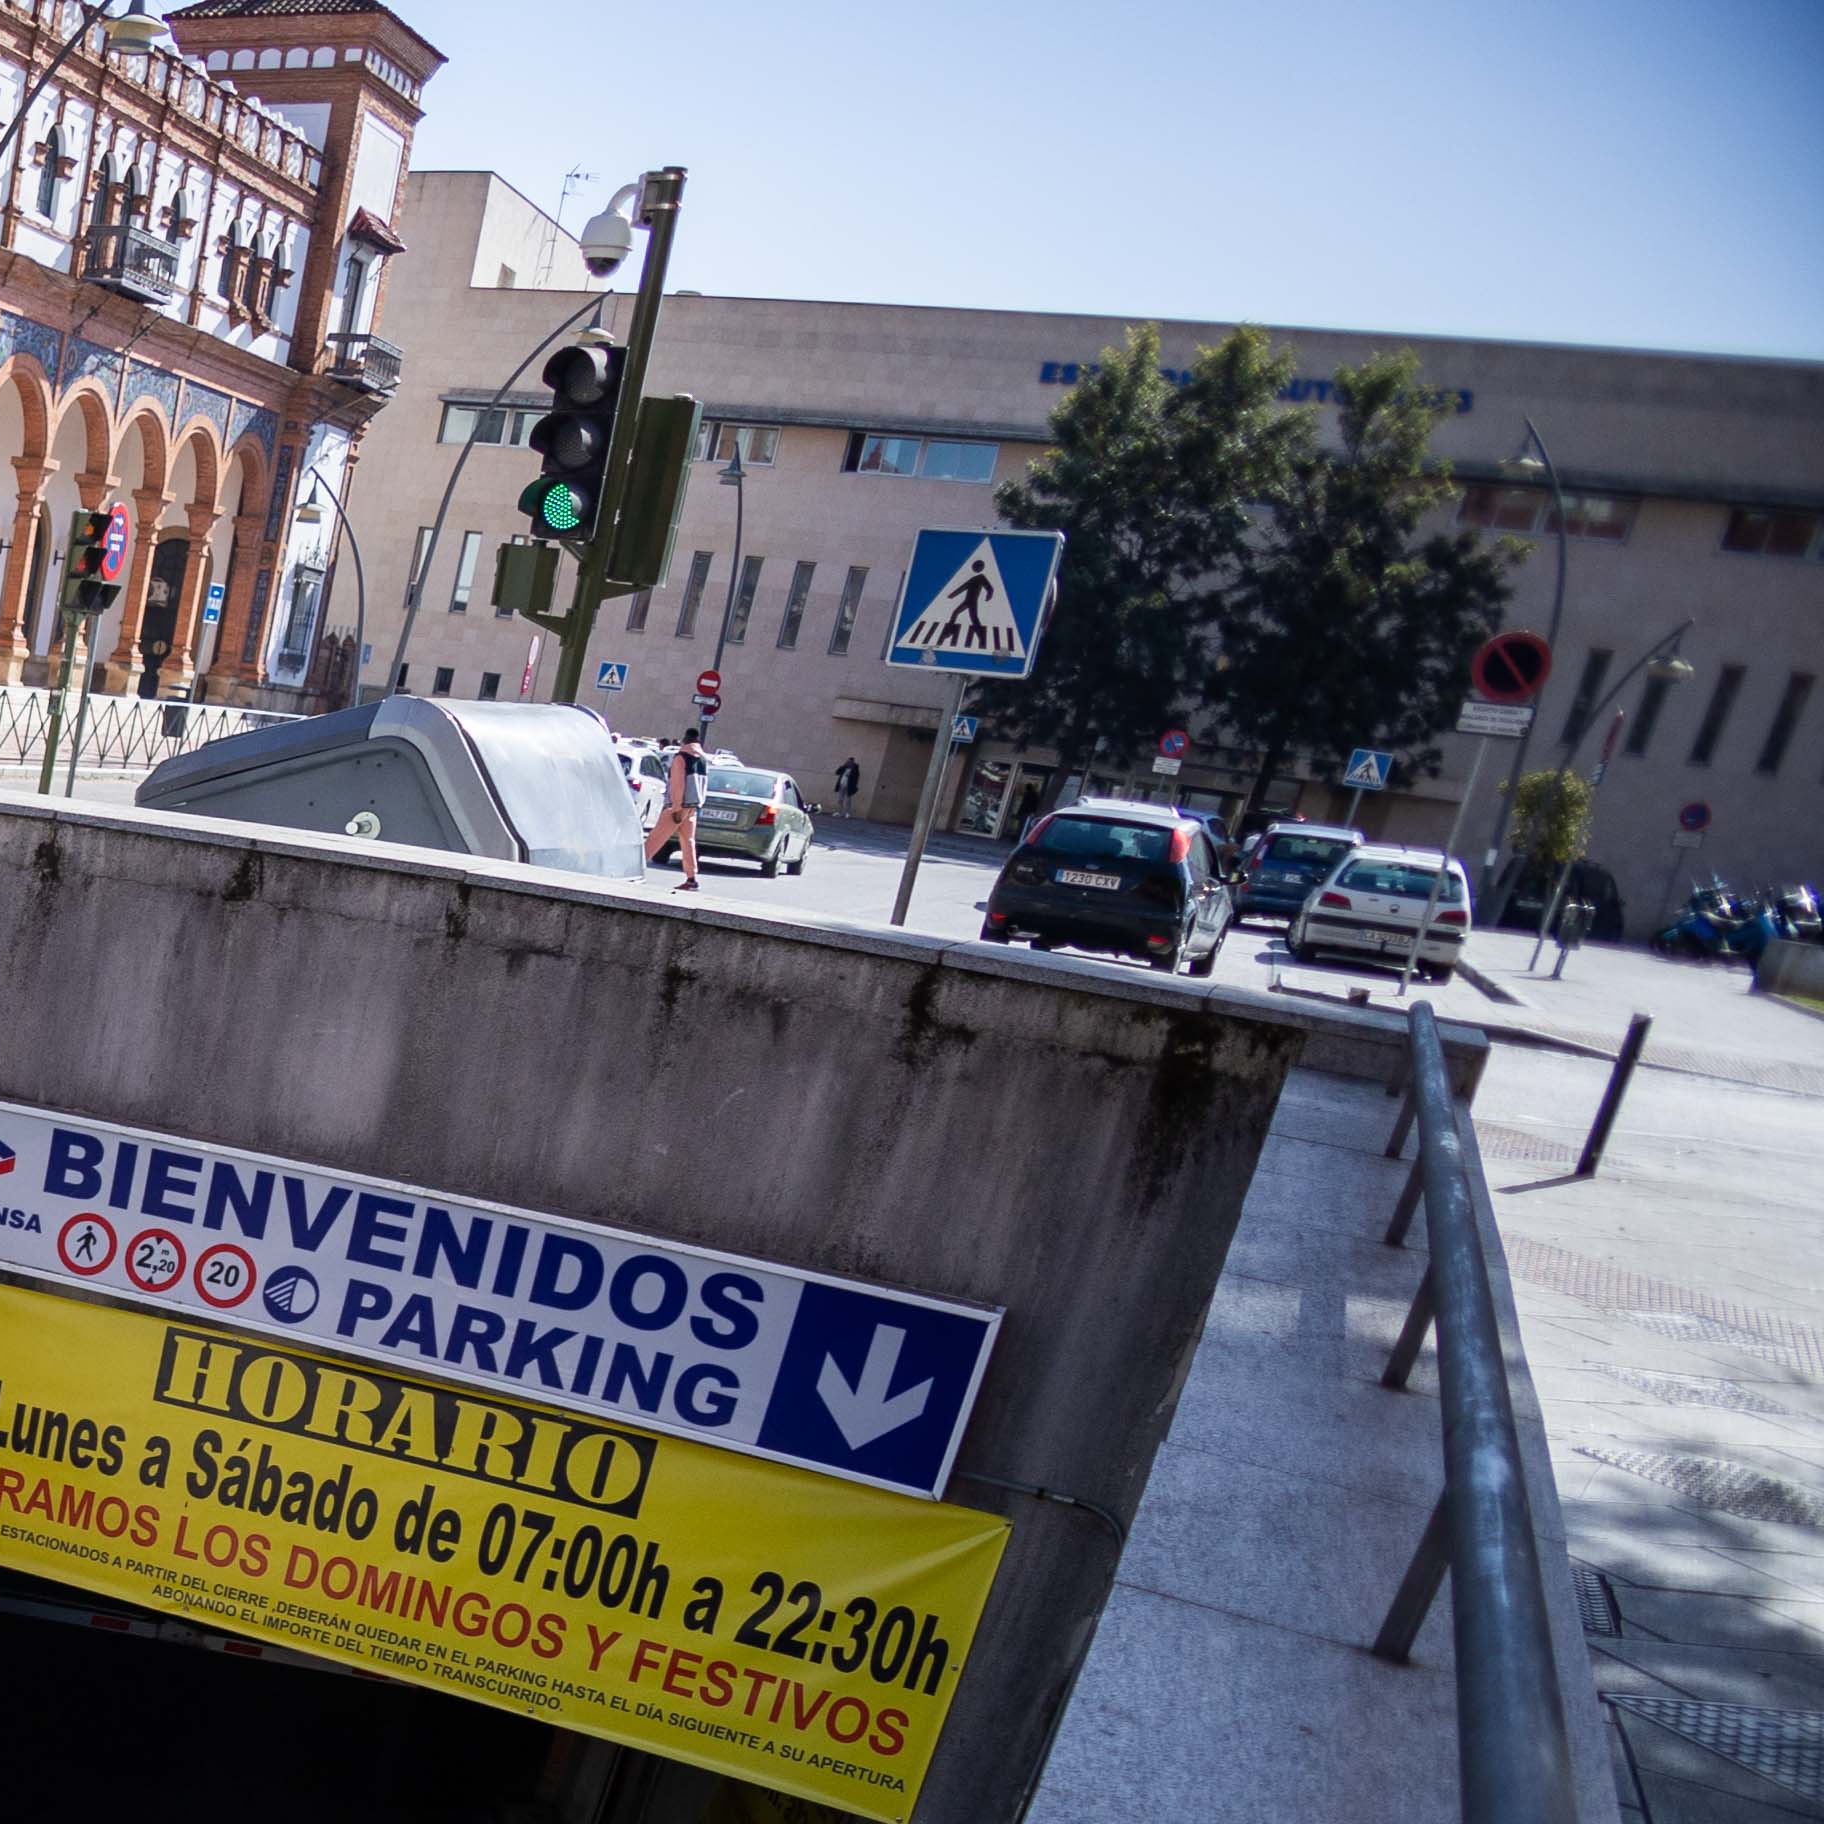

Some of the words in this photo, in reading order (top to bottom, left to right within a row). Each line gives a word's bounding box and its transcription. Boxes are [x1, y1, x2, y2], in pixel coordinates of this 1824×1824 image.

[43, 1127, 765, 1351] BIENVENIDOS
[206, 1260, 240, 1288] 20
[163, 1334, 641, 1508] HORARIO
[336, 1278, 740, 1427] PARKING
[0, 1524, 110, 1564] ESTACIONADOS
[111, 1555, 123, 1570] A
[125, 1558, 177, 1584] PARTIR
[180, 1574, 209, 1593] DEL
[213, 1583, 269, 1609] CIERRE
[354, 1623, 421, 1650] QUEDAR
[425, 1642, 448, 1659] EN
[451, 1650, 471, 1667] EL
[474, 1657, 548, 1688] PARKING
[551, 1678, 606, 1705] HASTA
[609, 1695, 630, 1711] EL
[635, 1703, 663, 1722] DÍA
[668, 1713, 761, 1750] SIGUIENTE
[762, 1741, 775, 1754] A
[779, 1744, 806, 1762] SU
[806, 1753, 906, 1793] APERTURA
[138, 1435, 172, 1489] a
[185, 1429, 379, 1541] Sábado
[393, 1484, 462, 1563] de
[478, 1502, 671, 1620] 07:00h
[682, 1576, 724, 1636] a
[734, 1570, 950, 1697] 22:30h
[152, 1584, 236, 1617] ABONANDO
[240, 1608, 260, 1625] EL
[262, 1614, 331, 1645] IMPORTE
[334, 1634, 365, 1655] DEL
[369, 1644, 428, 1672] TIEMPO
[432, 1663, 563, 1712] TRANSCURRIDO.
[172, 1515, 272, 1577] LOS
[283, 1544, 568, 1659] DOMINGOS
[586, 1624, 623, 1673] Y
[628, 1638, 910, 1757] FESTIVOS
